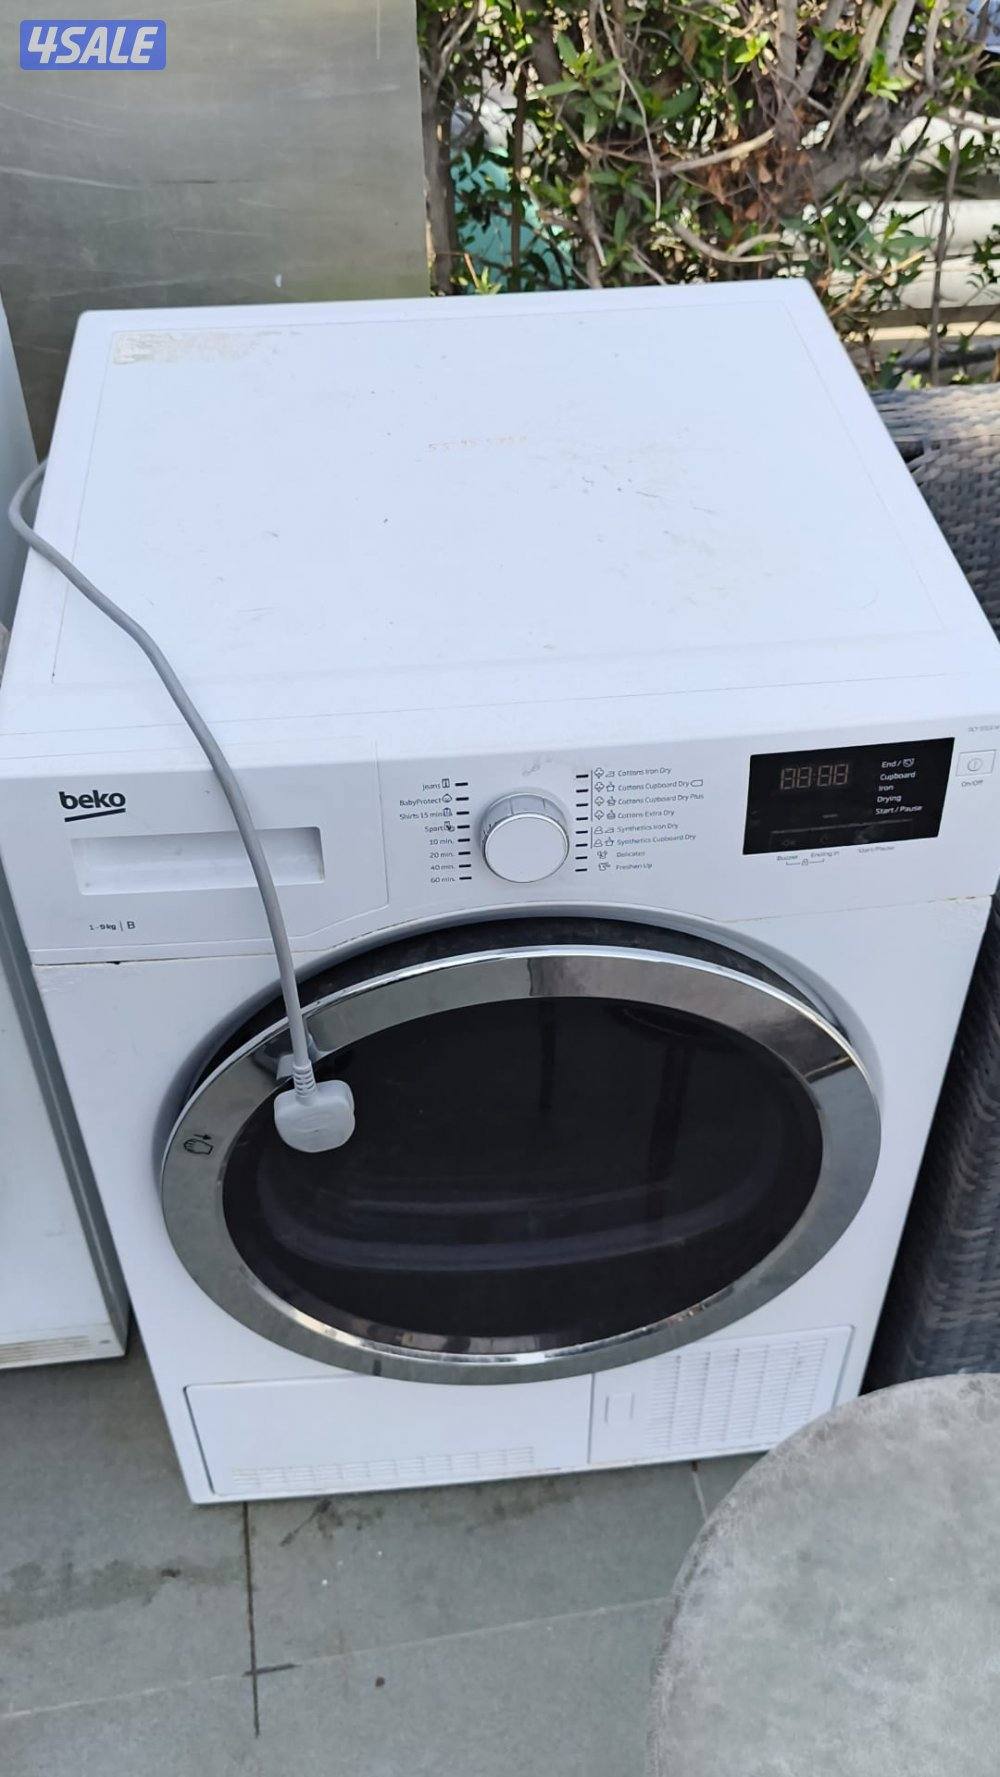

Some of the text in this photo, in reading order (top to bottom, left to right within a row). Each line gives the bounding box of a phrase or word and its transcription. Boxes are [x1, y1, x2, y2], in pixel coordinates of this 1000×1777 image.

[881, 760, 896, 769] End
[618, 769, 644, 777] Cottons
[660, 767, 671, 775] Dry
[879, 771, 916, 781] Cupboard
[618, 780, 689, 792] Cottons Cupboard Dry
[878, 784, 894, 792] Iron
[59, 790, 126, 810] beko
[618, 797, 644, 806] Cottons
[645, 795, 677, 804] Cupboard
[677, 794, 689, 802] Dry
[876, 795, 902, 804] Drying
[617, 809, 675, 819] Cottons Extra Dry
[875, 808, 894, 816] Start
[900, 805, 923, 813] Pause
[667, 822, 679, 831] Dry
[684, 833, 697, 842] Dry
[126, 920, 136, 930] B
